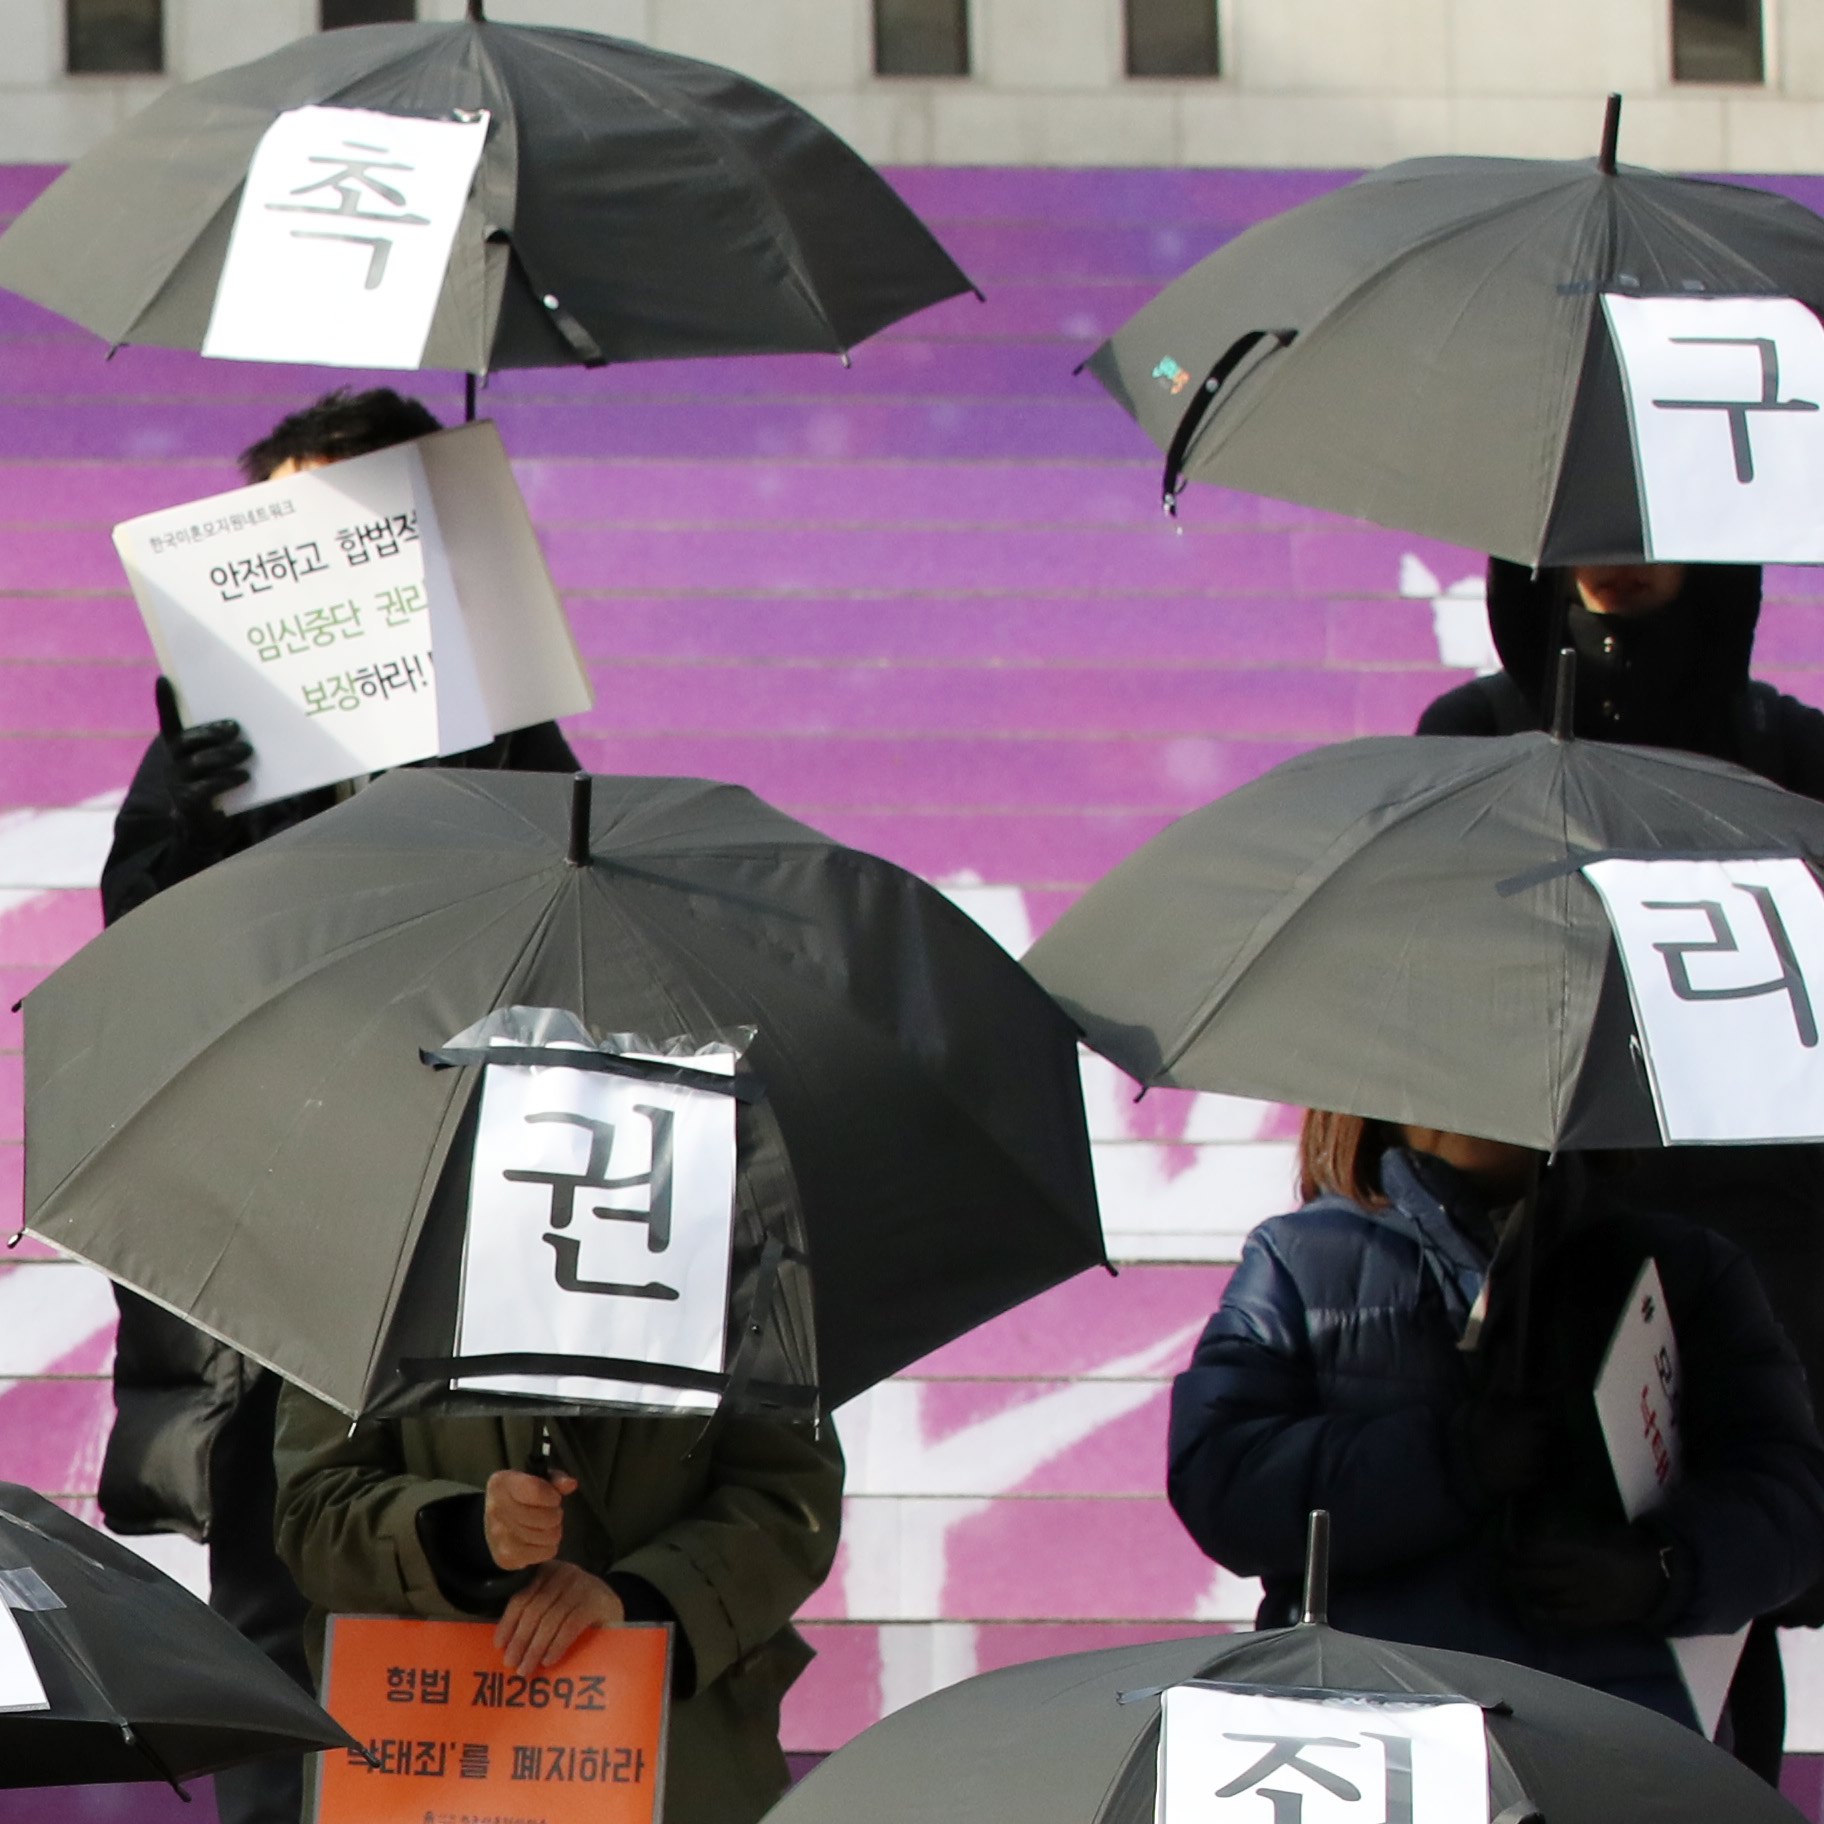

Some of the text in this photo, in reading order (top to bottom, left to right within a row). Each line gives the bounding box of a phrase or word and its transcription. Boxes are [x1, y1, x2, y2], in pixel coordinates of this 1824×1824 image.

[264, 141, 430, 290] 촉
[1653, 336, 1820, 484] 구
[210, 542, 328, 602] 안전하고
[246, 599, 365, 663] 임신중단
[1641, 883, 1818, 1048] 리
[503, 1102, 679, 1300] 권
[386, 1667, 606, 1711] 형법 제269조
[511, 1746, 644, 1783] 폐지하라
